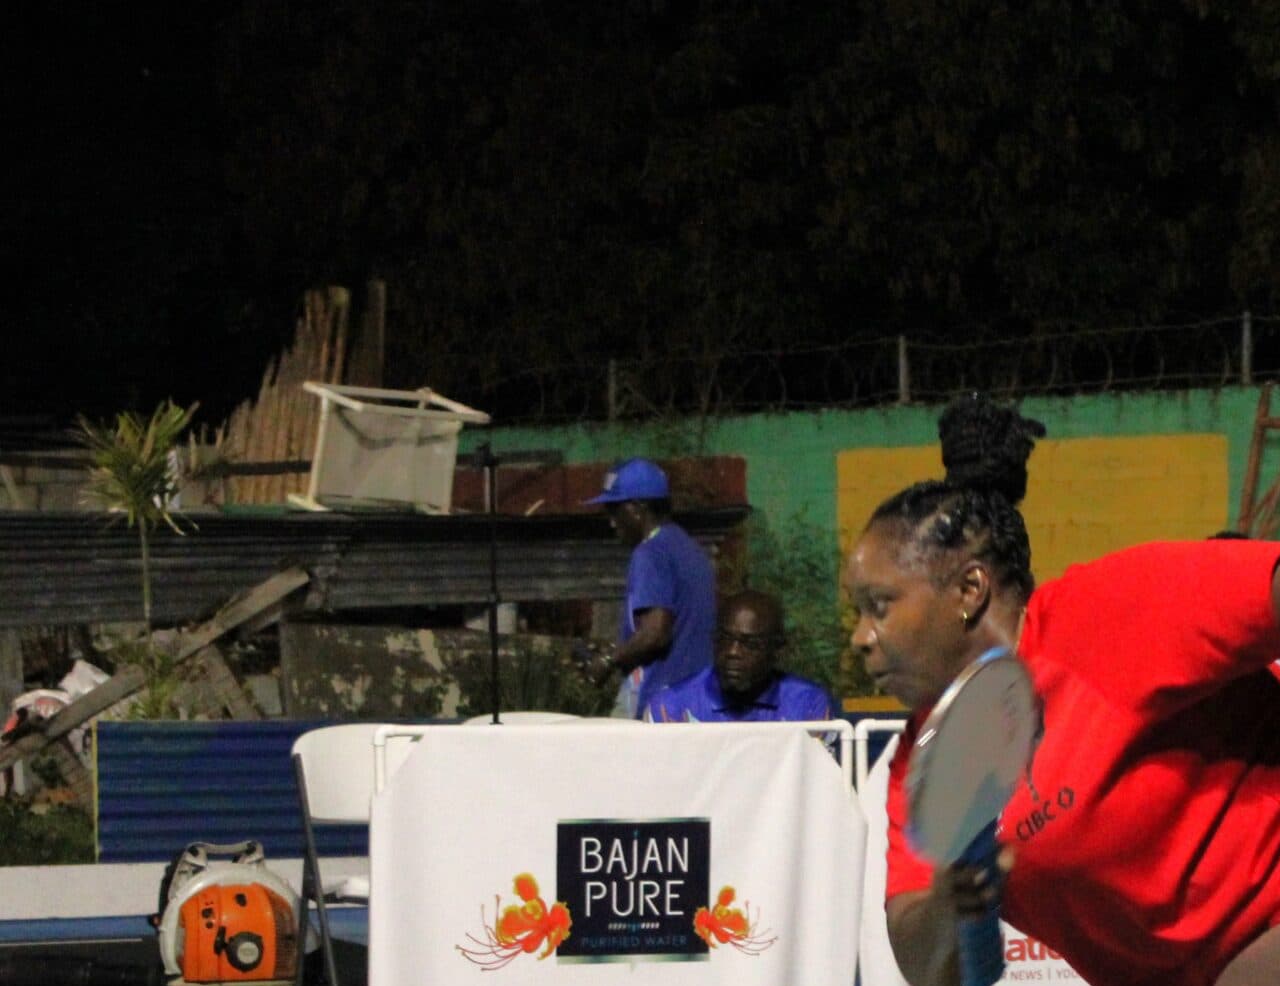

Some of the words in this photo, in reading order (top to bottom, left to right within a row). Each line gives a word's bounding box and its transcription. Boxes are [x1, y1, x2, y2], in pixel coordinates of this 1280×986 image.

[1015, 800, 1057, 842] CIBC
[580, 835, 690, 880] BAJAN
[584, 879, 685, 917] PURE
[1010, 969, 1043, 981] NEWS
